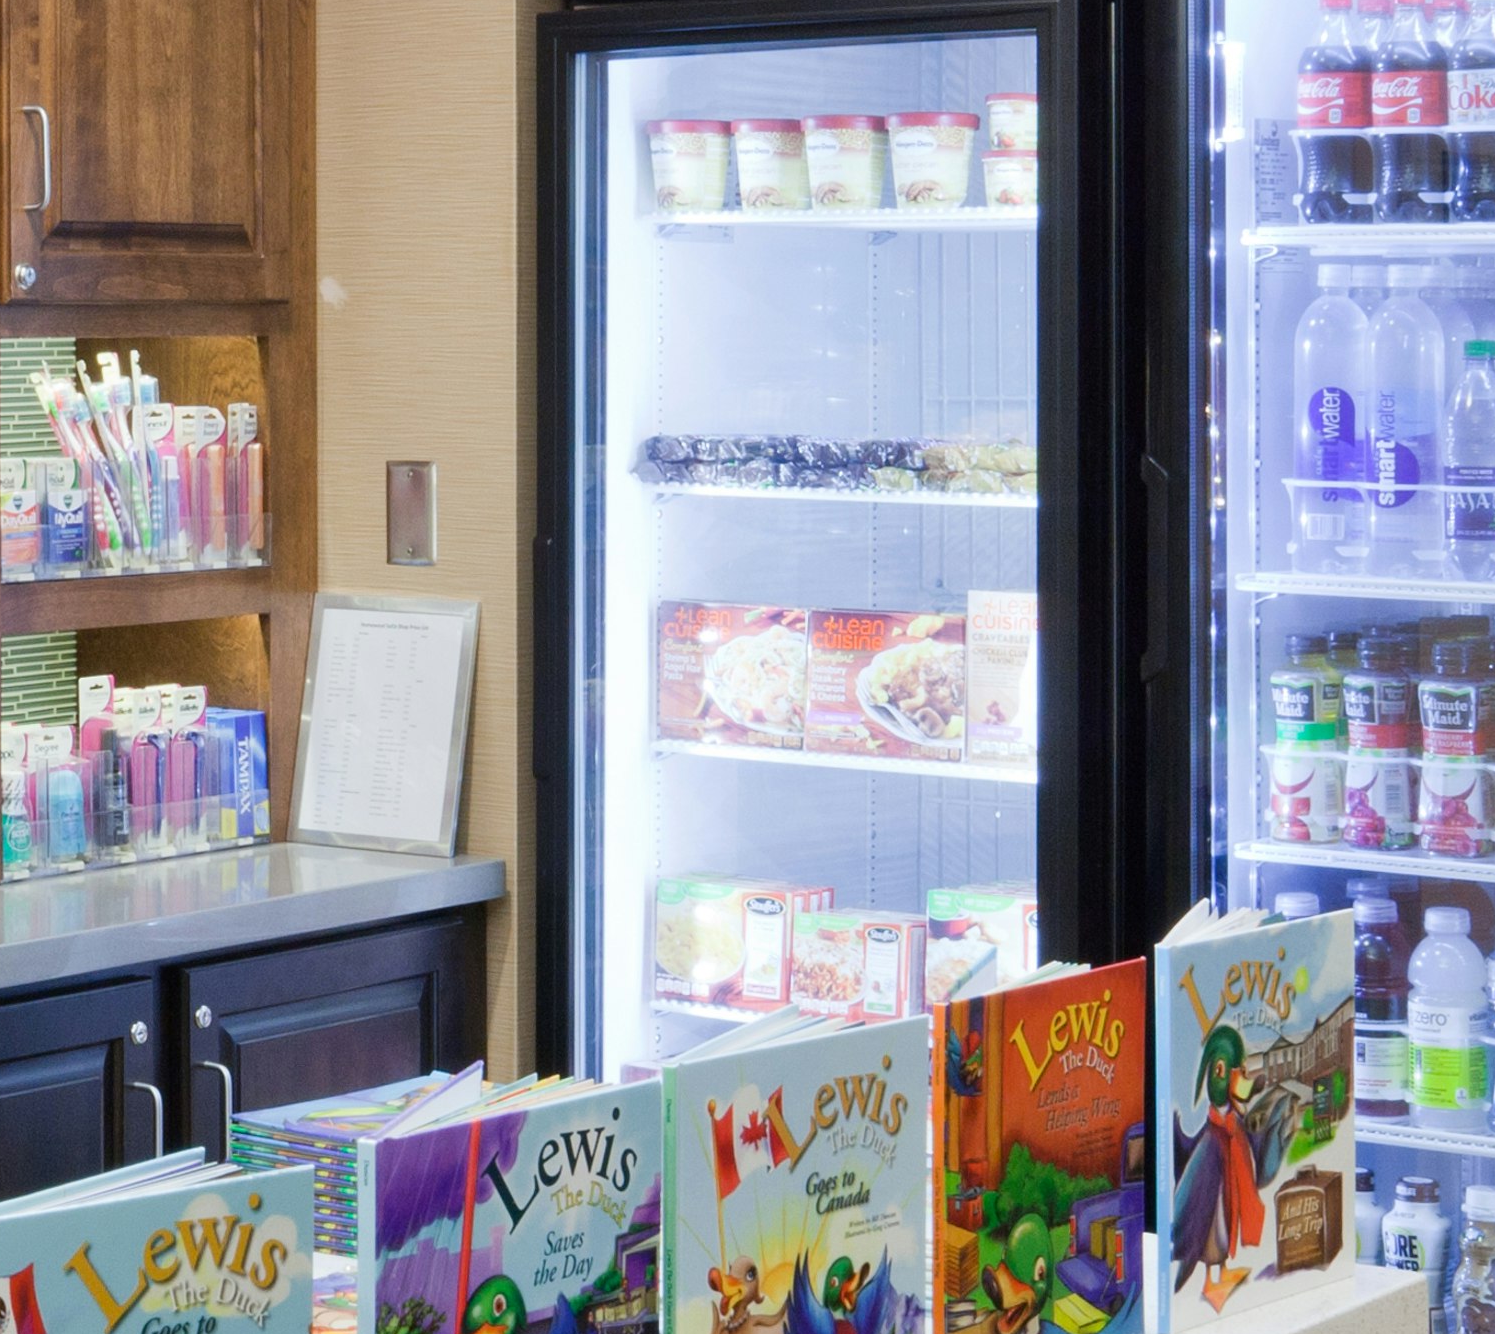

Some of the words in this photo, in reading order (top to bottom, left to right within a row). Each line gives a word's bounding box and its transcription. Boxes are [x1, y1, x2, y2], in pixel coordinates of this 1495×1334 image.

[689, 608, 731, 626] Lean
[837, 617, 885, 635] Lean
[1427, 709, 1464, 726] Maid
[34, 743, 60, 754] Degree
[237, 736, 252, 815] TAMPAX
[1179, 946, 1297, 1039] Lewis
[1232, 1010, 1255, 1031] The
[1414, 1011, 1448, 1026] zero
[1009, 989, 1125, 1092] Lewis
[1059, 1049, 1084, 1074] The
[1086, 1046, 1115, 1084] Duck
[763, 1055, 909, 1173] Lewis
[825, 1125, 857, 1155] The
[859, 1122, 897, 1167] Duck
[481, 1107, 639, 1235] Lewis
[805, 1171, 838, 1196] Goes
[842, 1170, 856, 1188] to
[550, 1186, 585, 1216] The
[587, 1185, 627, 1231] Duck
[815, 1181, 871, 1215] Canada
[1281, 1197, 1303, 1221] And
[1303, 1196, 1320, 1214] His
[544, 1229, 585, 1258] Saves
[1278, 1220, 1302, 1241] Long
[1303, 1216, 1323, 1236] Trip
[533, 1258, 558, 1286] the
[561, 1253, 594, 1287] Day
[163, 1279, 208, 1315] The
[215, 1276, 271, 1330] Duck
